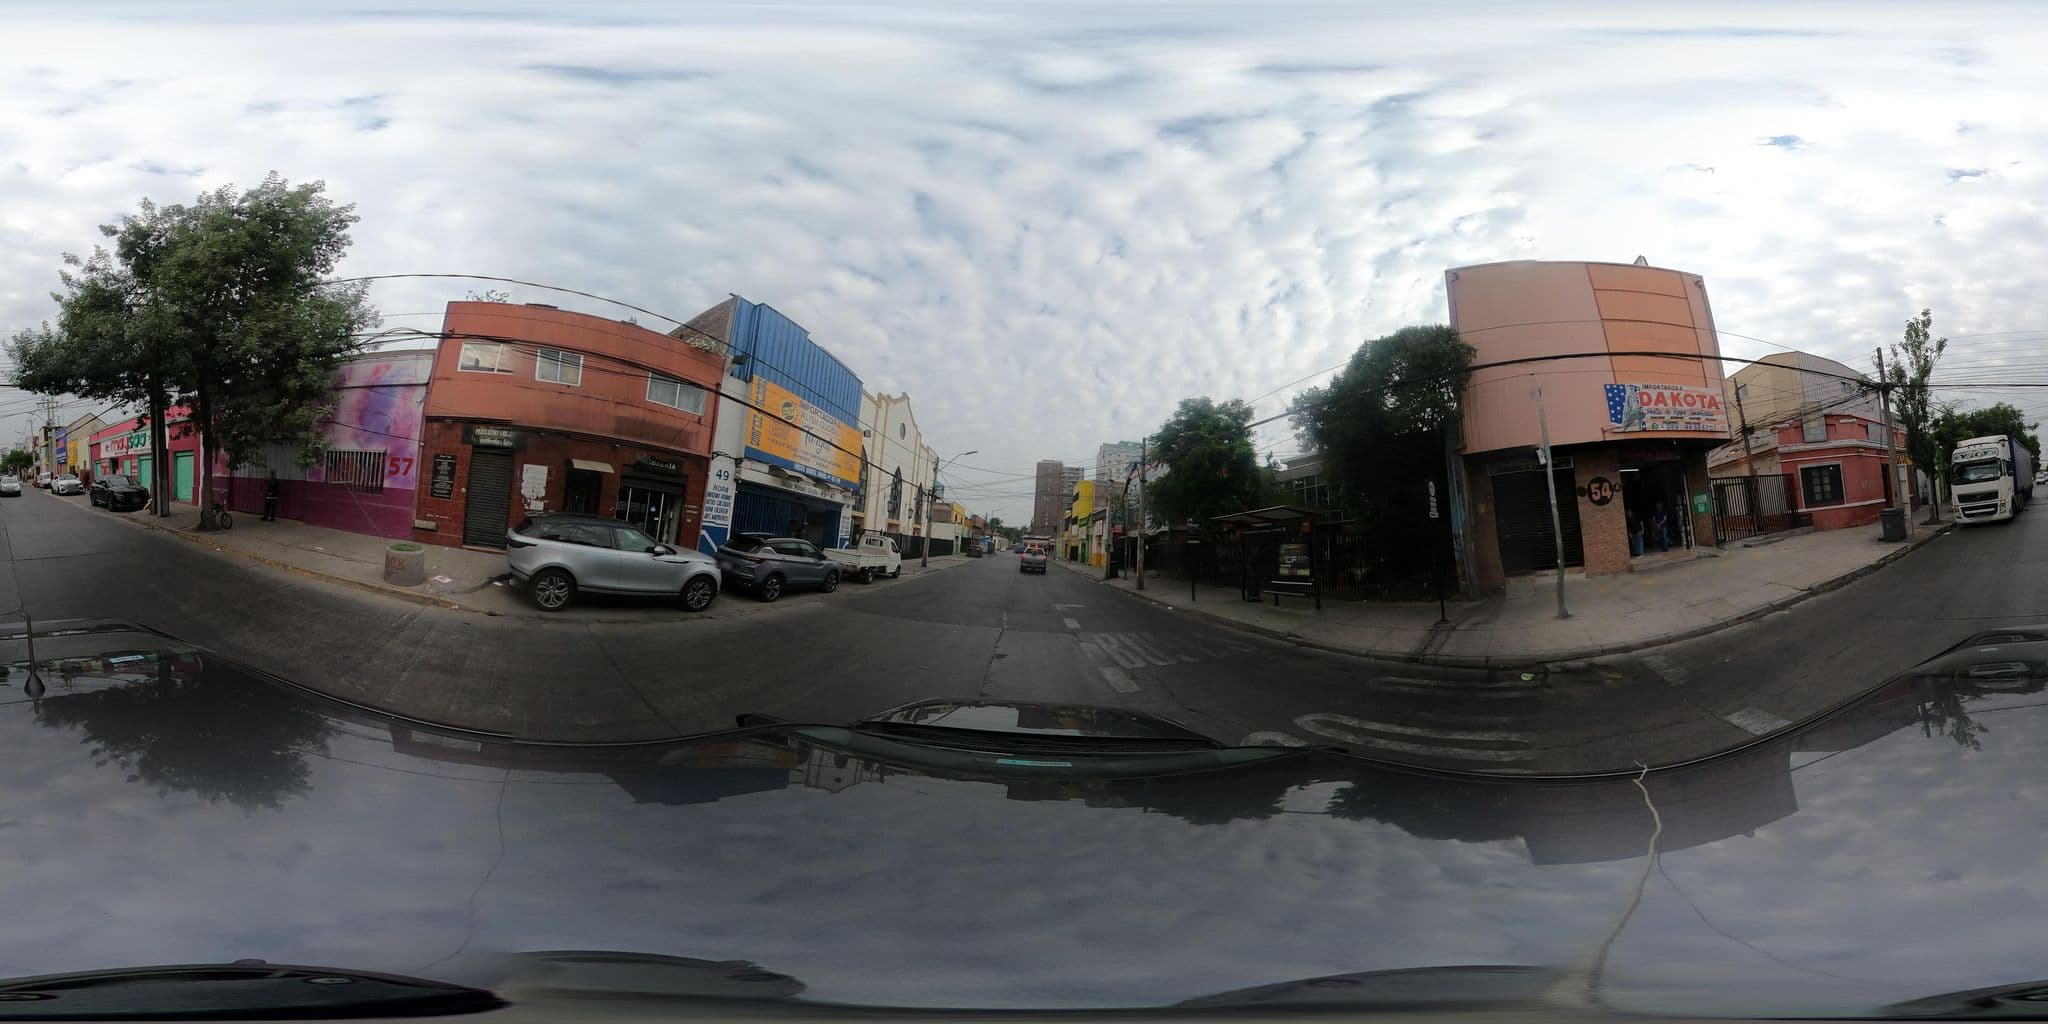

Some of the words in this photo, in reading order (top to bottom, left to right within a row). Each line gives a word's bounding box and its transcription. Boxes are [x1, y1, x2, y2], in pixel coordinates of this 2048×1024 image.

[1639, 391, 1720, 410] DAKOTA
[388, 457, 414, 477] 57
[715, 469, 730, 481] 49
[1590, 481, 1612, 500] 54
